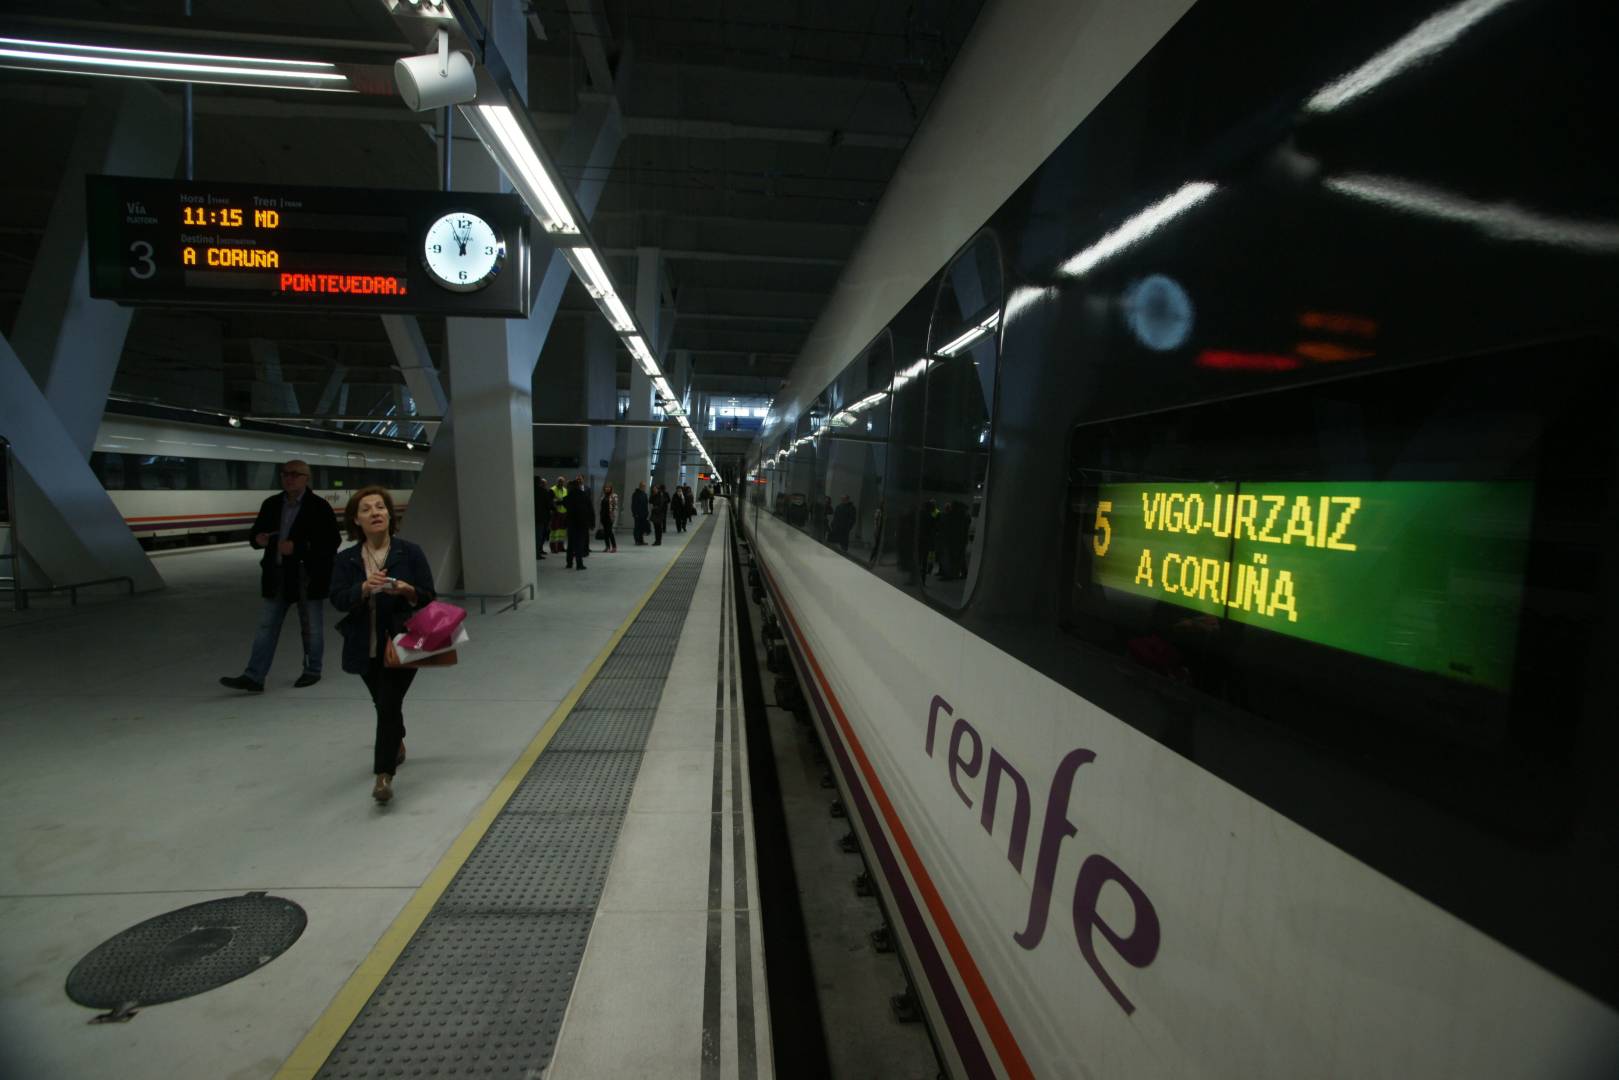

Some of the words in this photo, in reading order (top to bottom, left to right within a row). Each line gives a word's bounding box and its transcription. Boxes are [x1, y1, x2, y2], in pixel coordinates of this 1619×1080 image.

[253, 196, 277, 207] Tren
[183, 206, 244, 227] 11:15
[254, 208, 280, 229] MD
[457, 219, 473, 229] 12
[128, 240, 157, 280] 3
[183, 246, 197, 266] A
[207, 247, 280, 269] CORUÑA
[432, 244, 442, 254] 9
[484, 246, 494, 256] 3
[458, 270, 468, 281] 6
[1092, 501, 1113, 557] 5
[1142, 491, 1362, 552] VIGO-URZAIZ
[1135, 548, 1154, 588] A
[1160, 552, 1298, 623] CORUÑA
[925, 694, 1161, 1017] renfe
